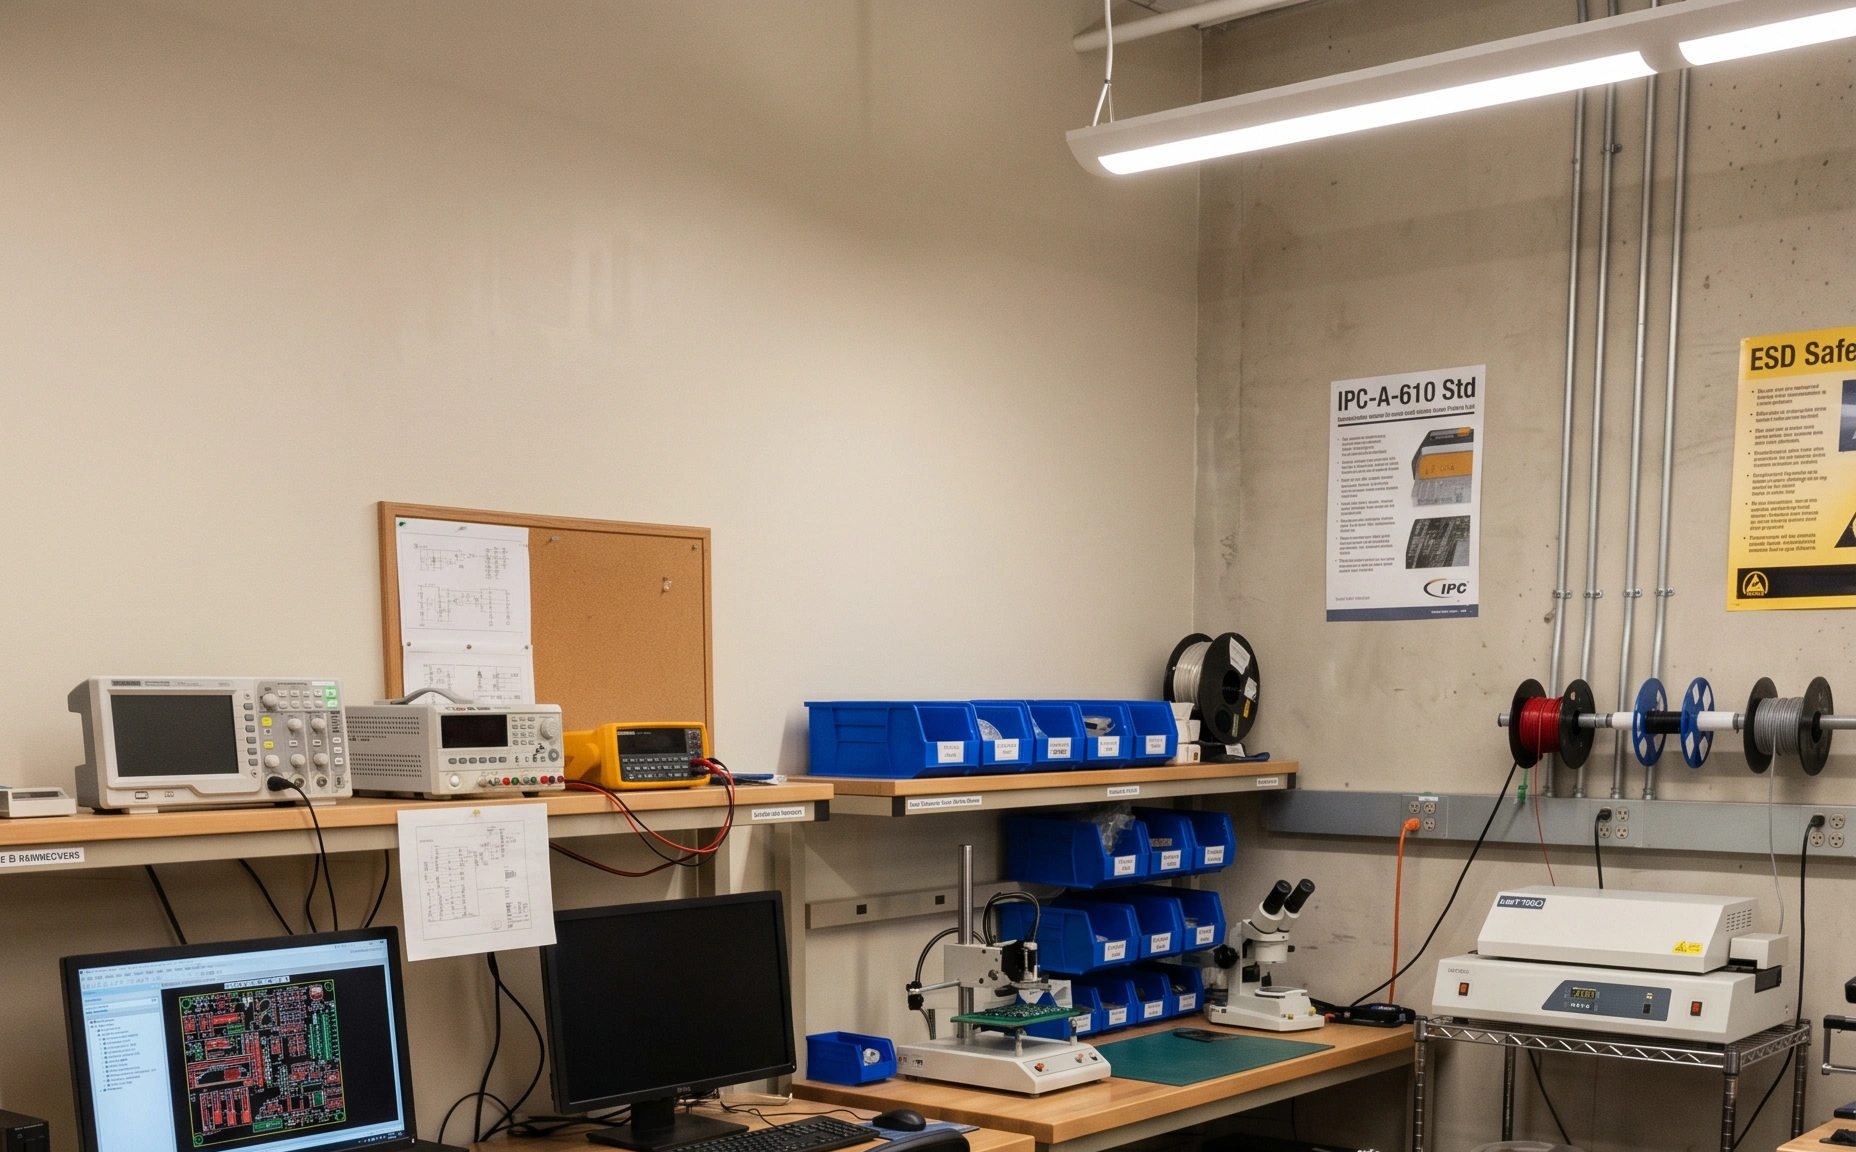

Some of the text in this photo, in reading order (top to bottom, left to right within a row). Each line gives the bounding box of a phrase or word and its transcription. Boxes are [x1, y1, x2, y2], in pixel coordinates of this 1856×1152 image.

[1750, 338, 1856, 371] ESD Safe
[1338, 376, 1476, 411] IPC-A-610 Std
[1440, 582, 1467, 595] IPC
